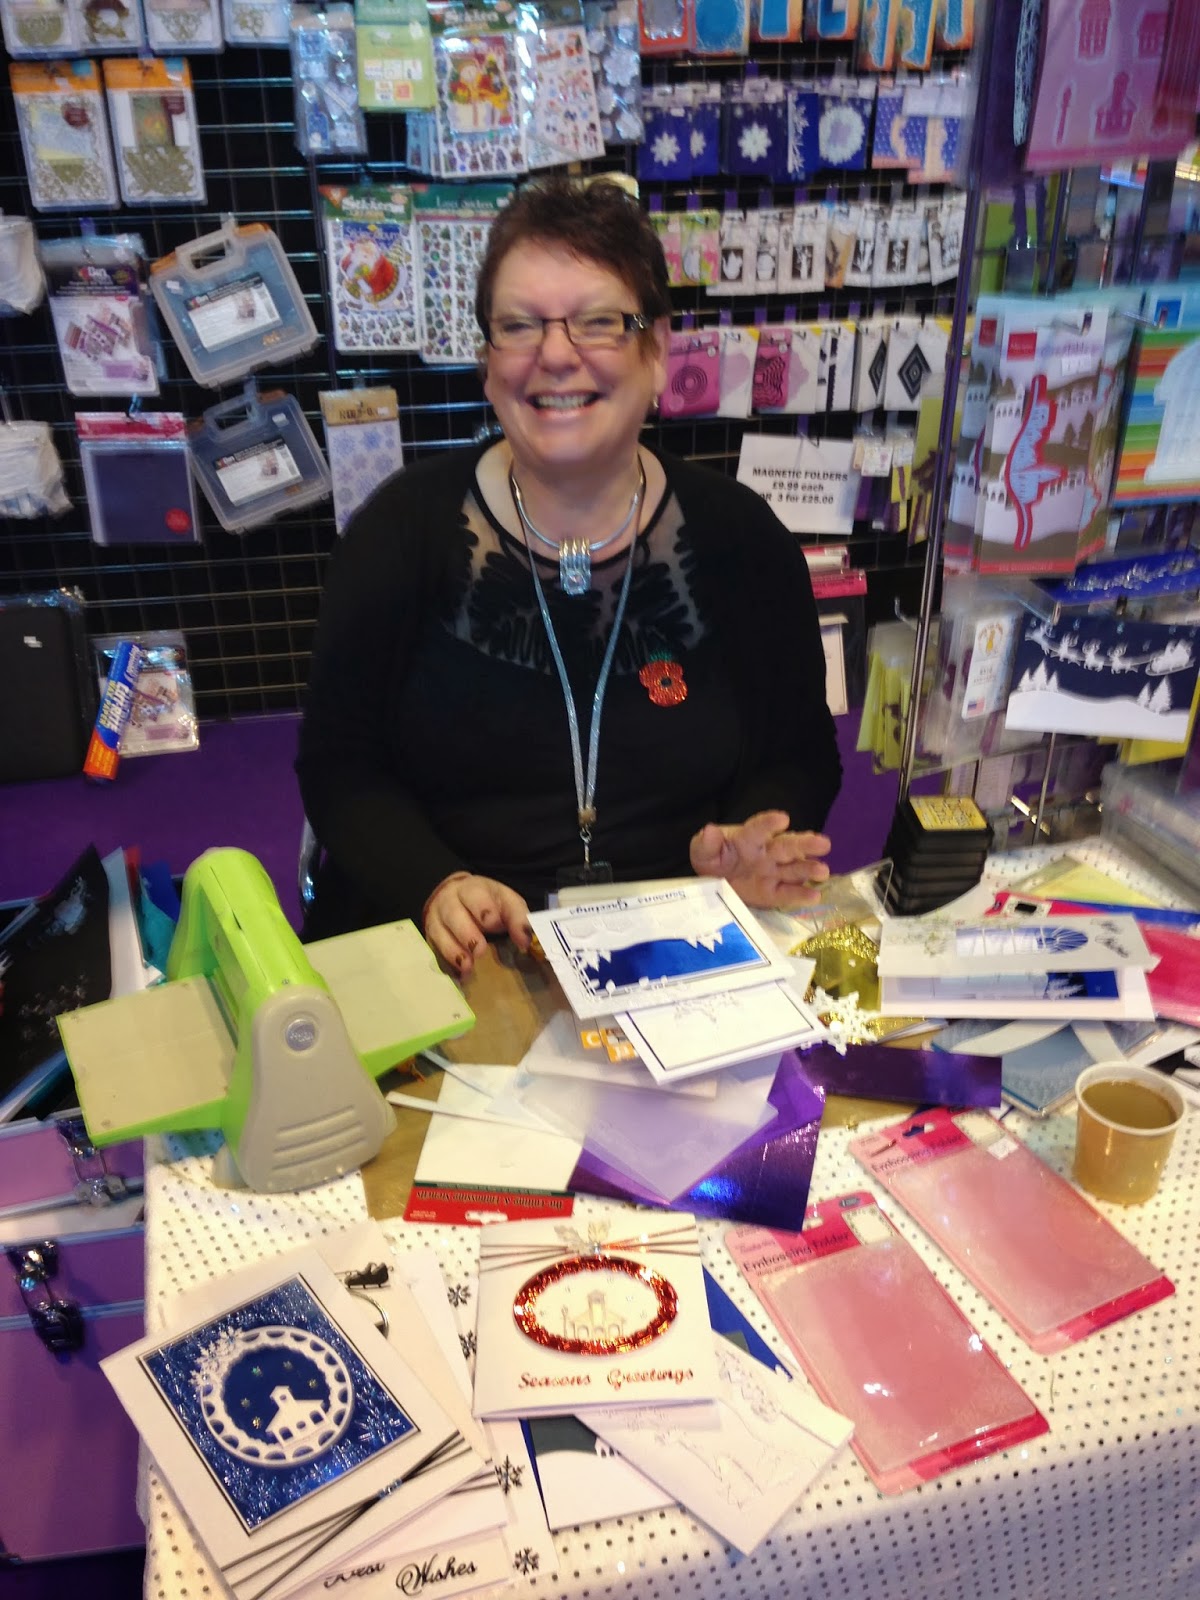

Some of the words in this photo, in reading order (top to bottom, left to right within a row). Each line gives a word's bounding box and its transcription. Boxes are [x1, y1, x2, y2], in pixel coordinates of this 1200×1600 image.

[752, 467, 802, 480] MAGNETIC
[804, 470, 848, 482] FOLDERS
[772, 481, 799, 491] £9.99
[801, 483, 824, 492] each
[778, 493, 783, 503] 3
[785, 494, 799, 504] for
[802, 495, 834, 505] £25.00
[743, 1243, 813, 1273] Embossing
[518, 1371, 591, 1389] Seasons
[607, 1368, 694, 1391] Greetings
[395, 1552, 478, 1597] Wishes
